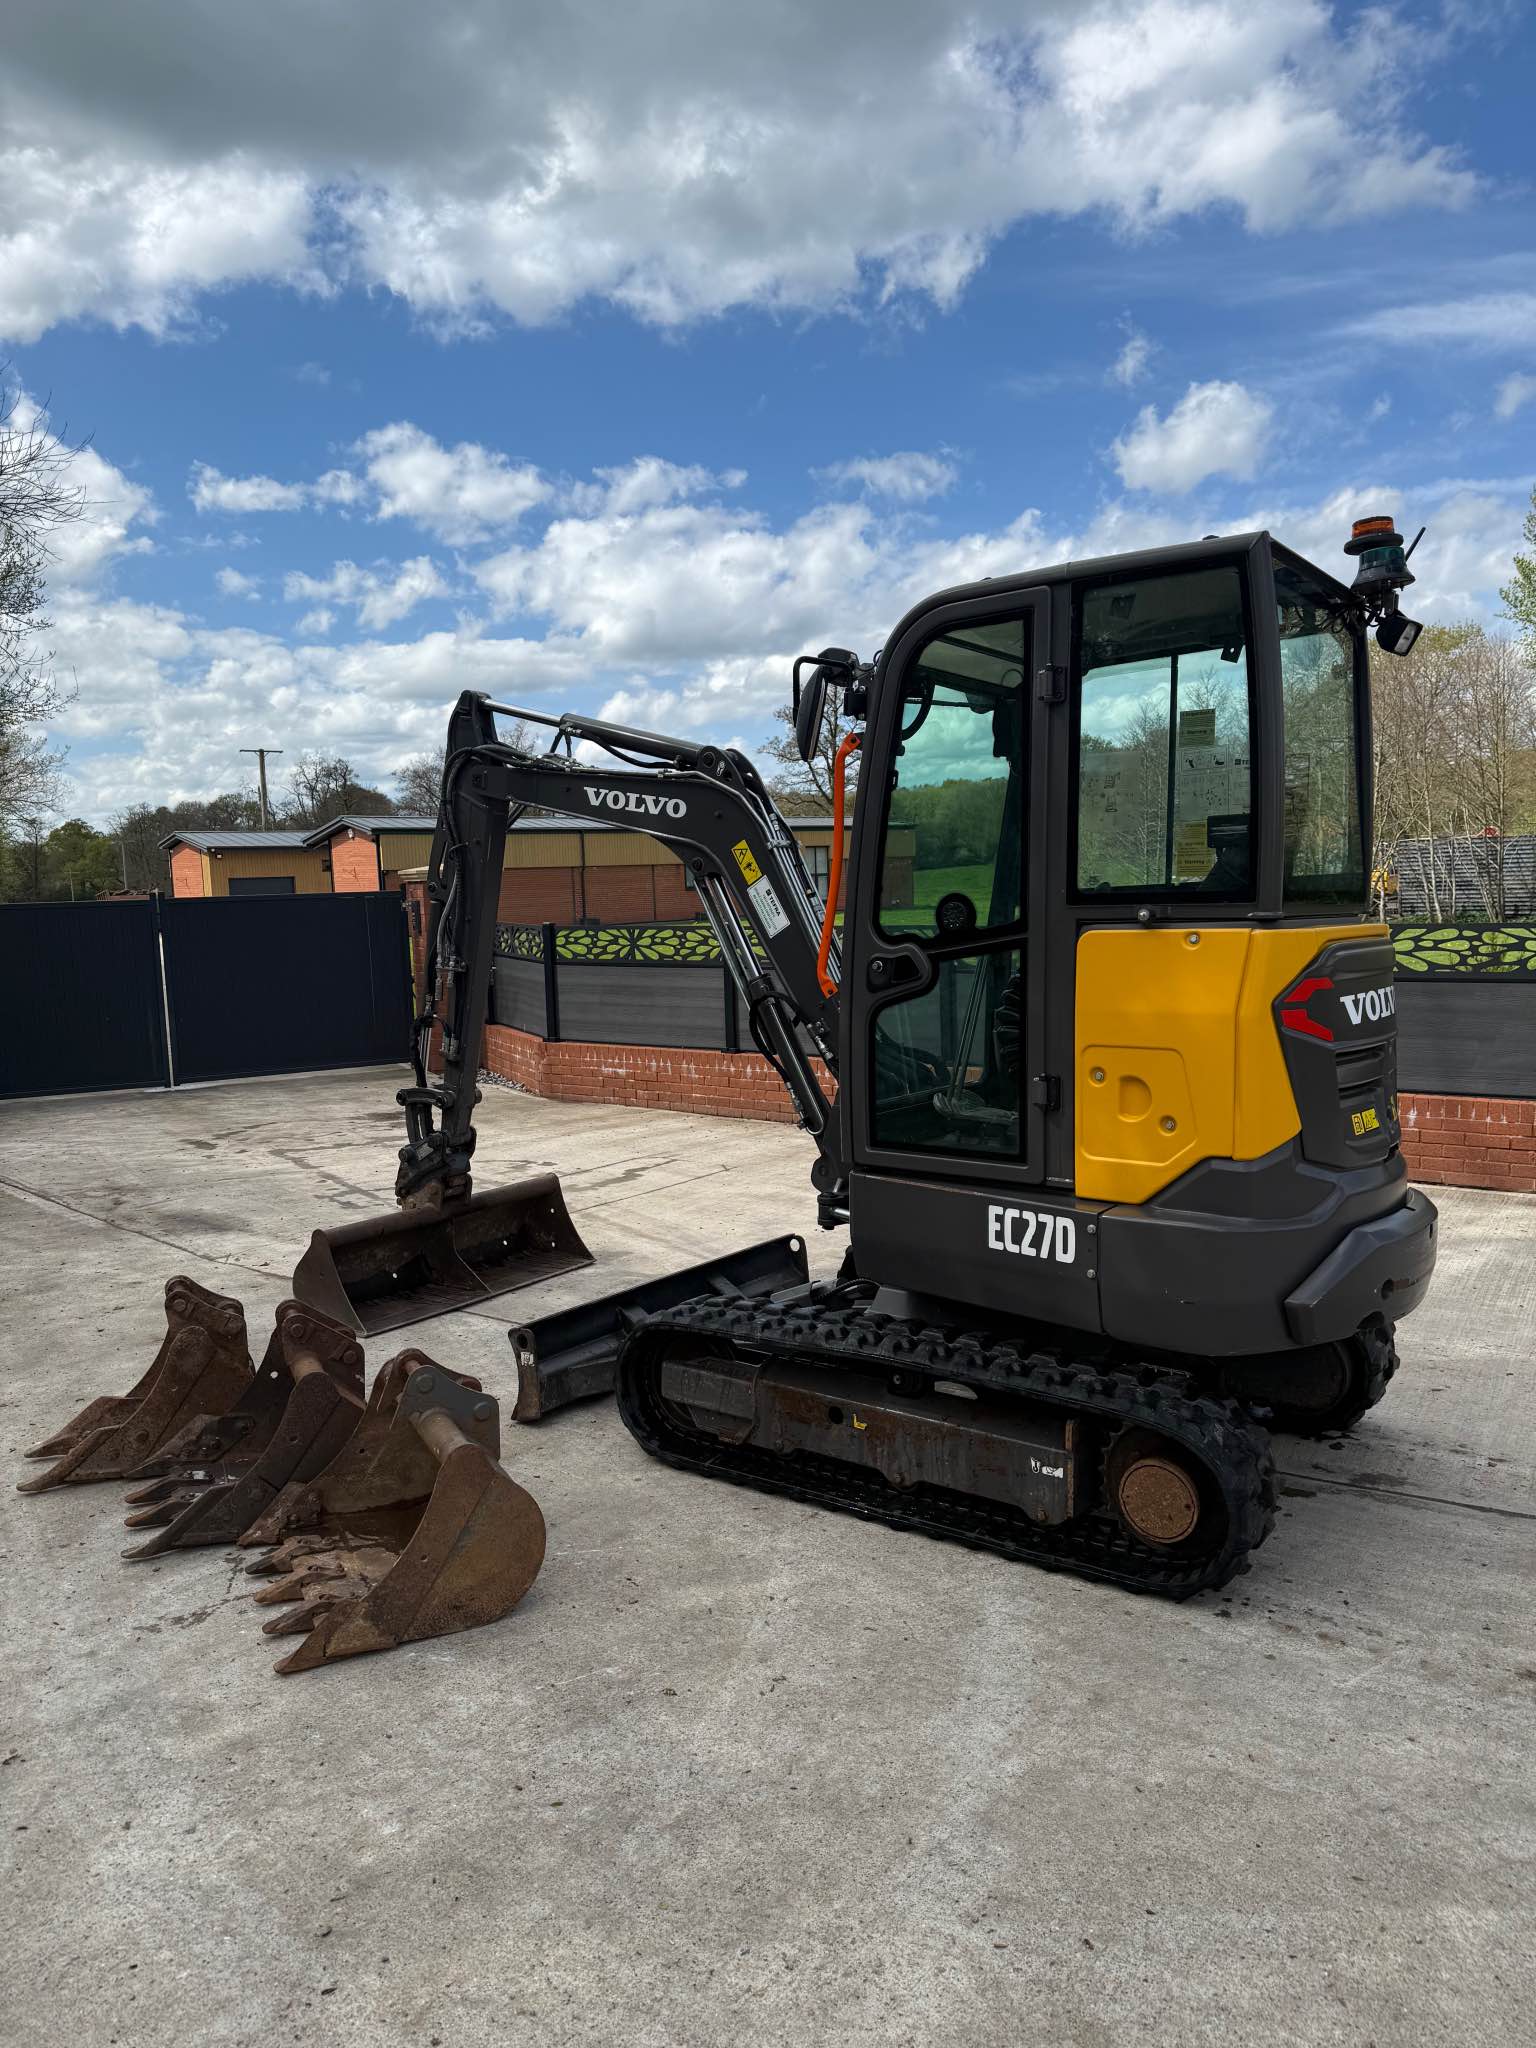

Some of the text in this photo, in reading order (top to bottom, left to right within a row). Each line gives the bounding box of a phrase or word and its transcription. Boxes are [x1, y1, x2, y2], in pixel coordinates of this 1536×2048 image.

[583, 786, 687, 818] VOLVO
[1339, 985, 1395, 1025] VOLV
[988, 1204, 1076, 1264] EC27D
